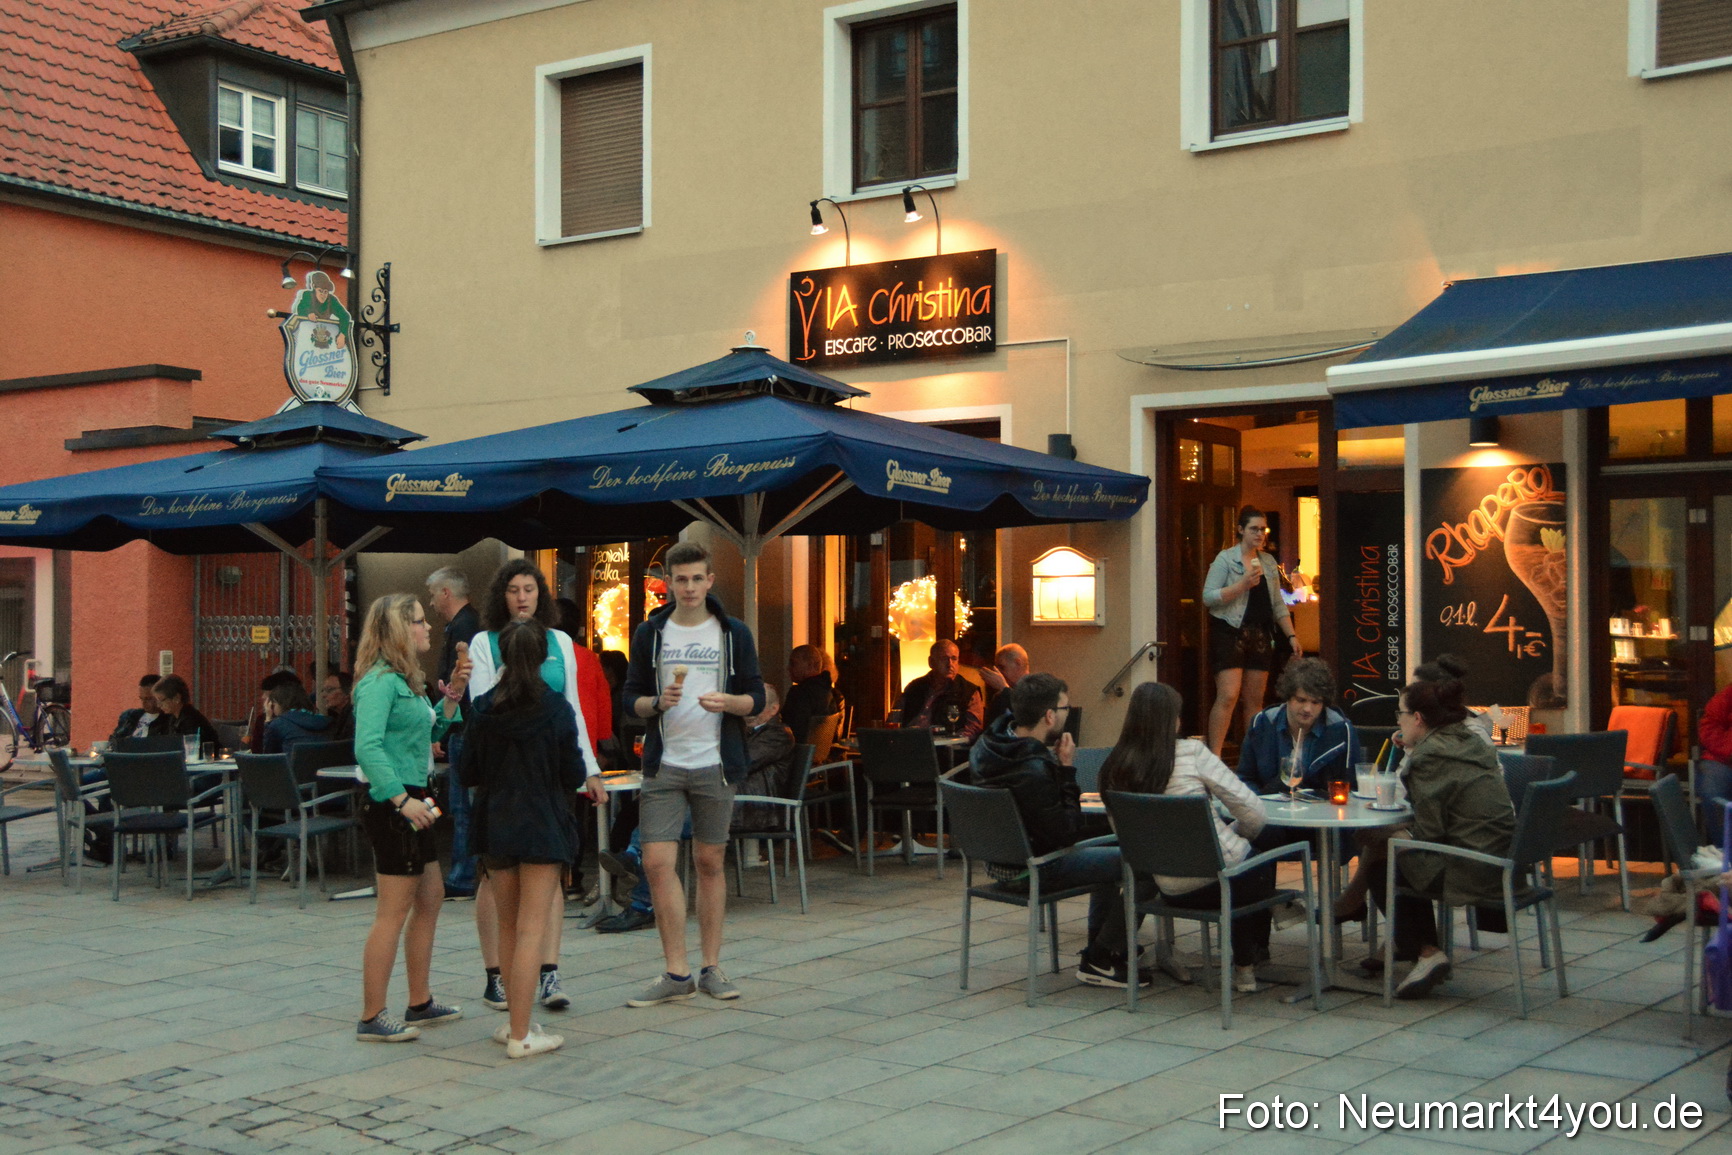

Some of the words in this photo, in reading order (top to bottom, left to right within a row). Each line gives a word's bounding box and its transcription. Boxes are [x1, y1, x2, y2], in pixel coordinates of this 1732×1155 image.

[869, 277, 992, 325] Christina
[299, 349, 346, 376] Glossner
[325, 365, 347, 379] Bier
[1470, 378, 1570, 412] Glossner-Bier
[385, 472, 474, 503] Glossner-Bier
[589, 466, 623, 490] Der
[627, 460, 698, 491] hochfeine
[702, 453, 797, 483] Biergenuss
[886, 459, 952, 494] Glossner-Bier
[139, 495, 165, 517] Der
[168, 493, 223, 519] hochfeine
[226, 490, 298, 513] Biergenuss
[1354, 545, 1381, 643] Christina
